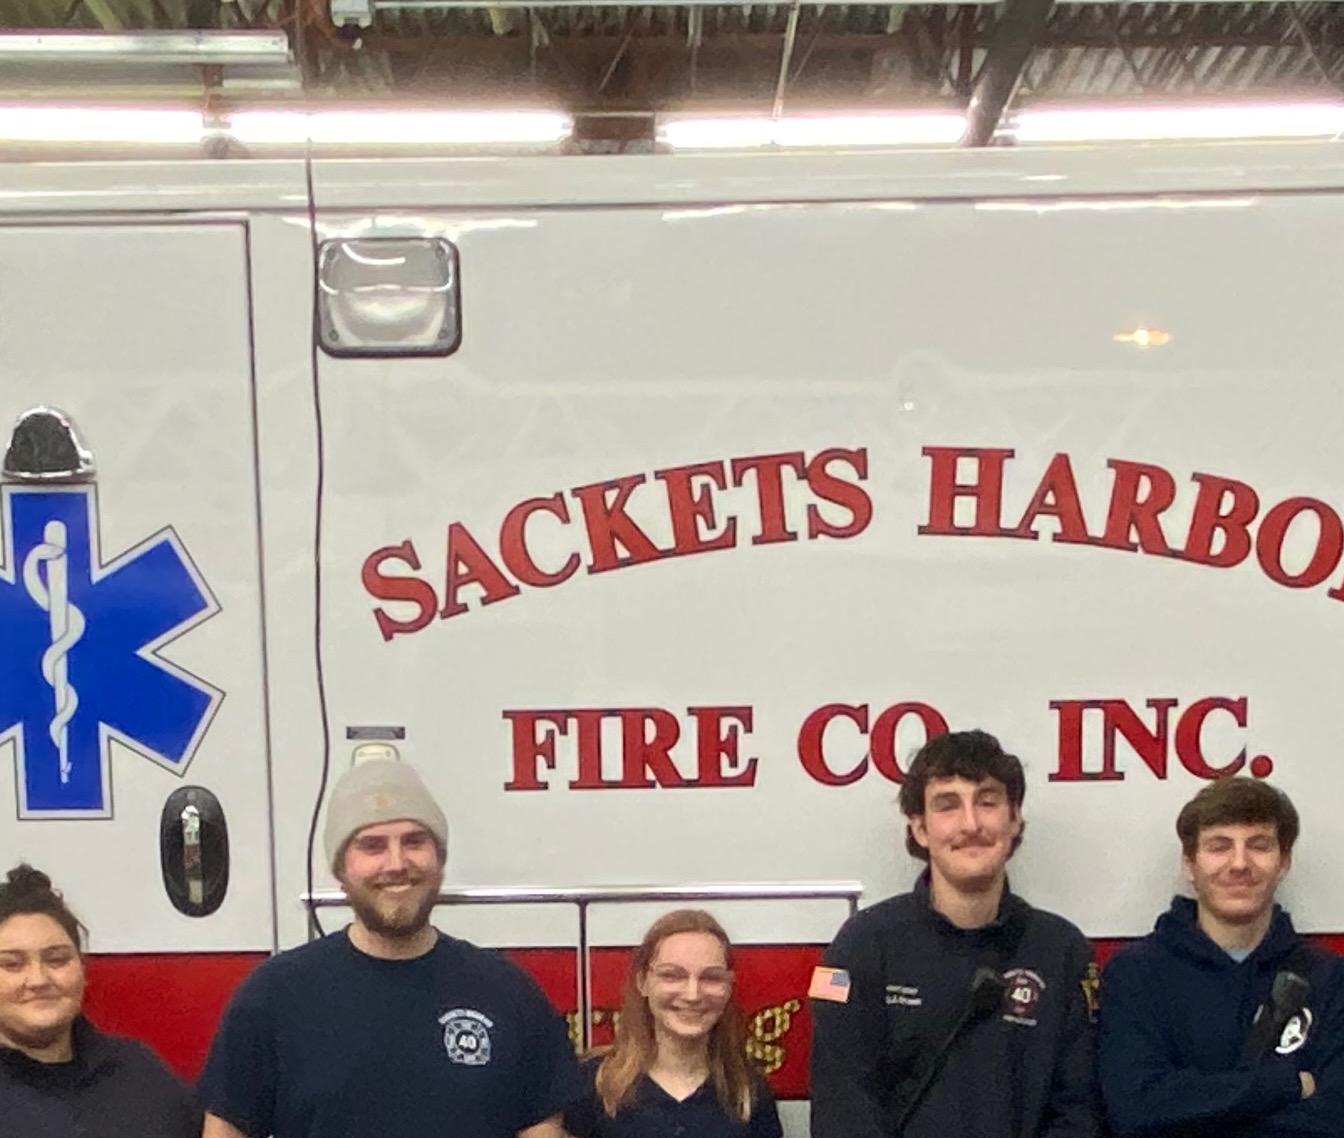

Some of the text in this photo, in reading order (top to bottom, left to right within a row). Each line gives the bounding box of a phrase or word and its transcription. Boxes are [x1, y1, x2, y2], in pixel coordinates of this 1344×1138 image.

[360, 447, 874, 642] SACKETS
[502, 705, 758, 792] FIRE
[1048, 697, 1274, 782] INC.
[1010, 986, 1032, 1004] 40
[457, 1033, 478, 1051] 40
